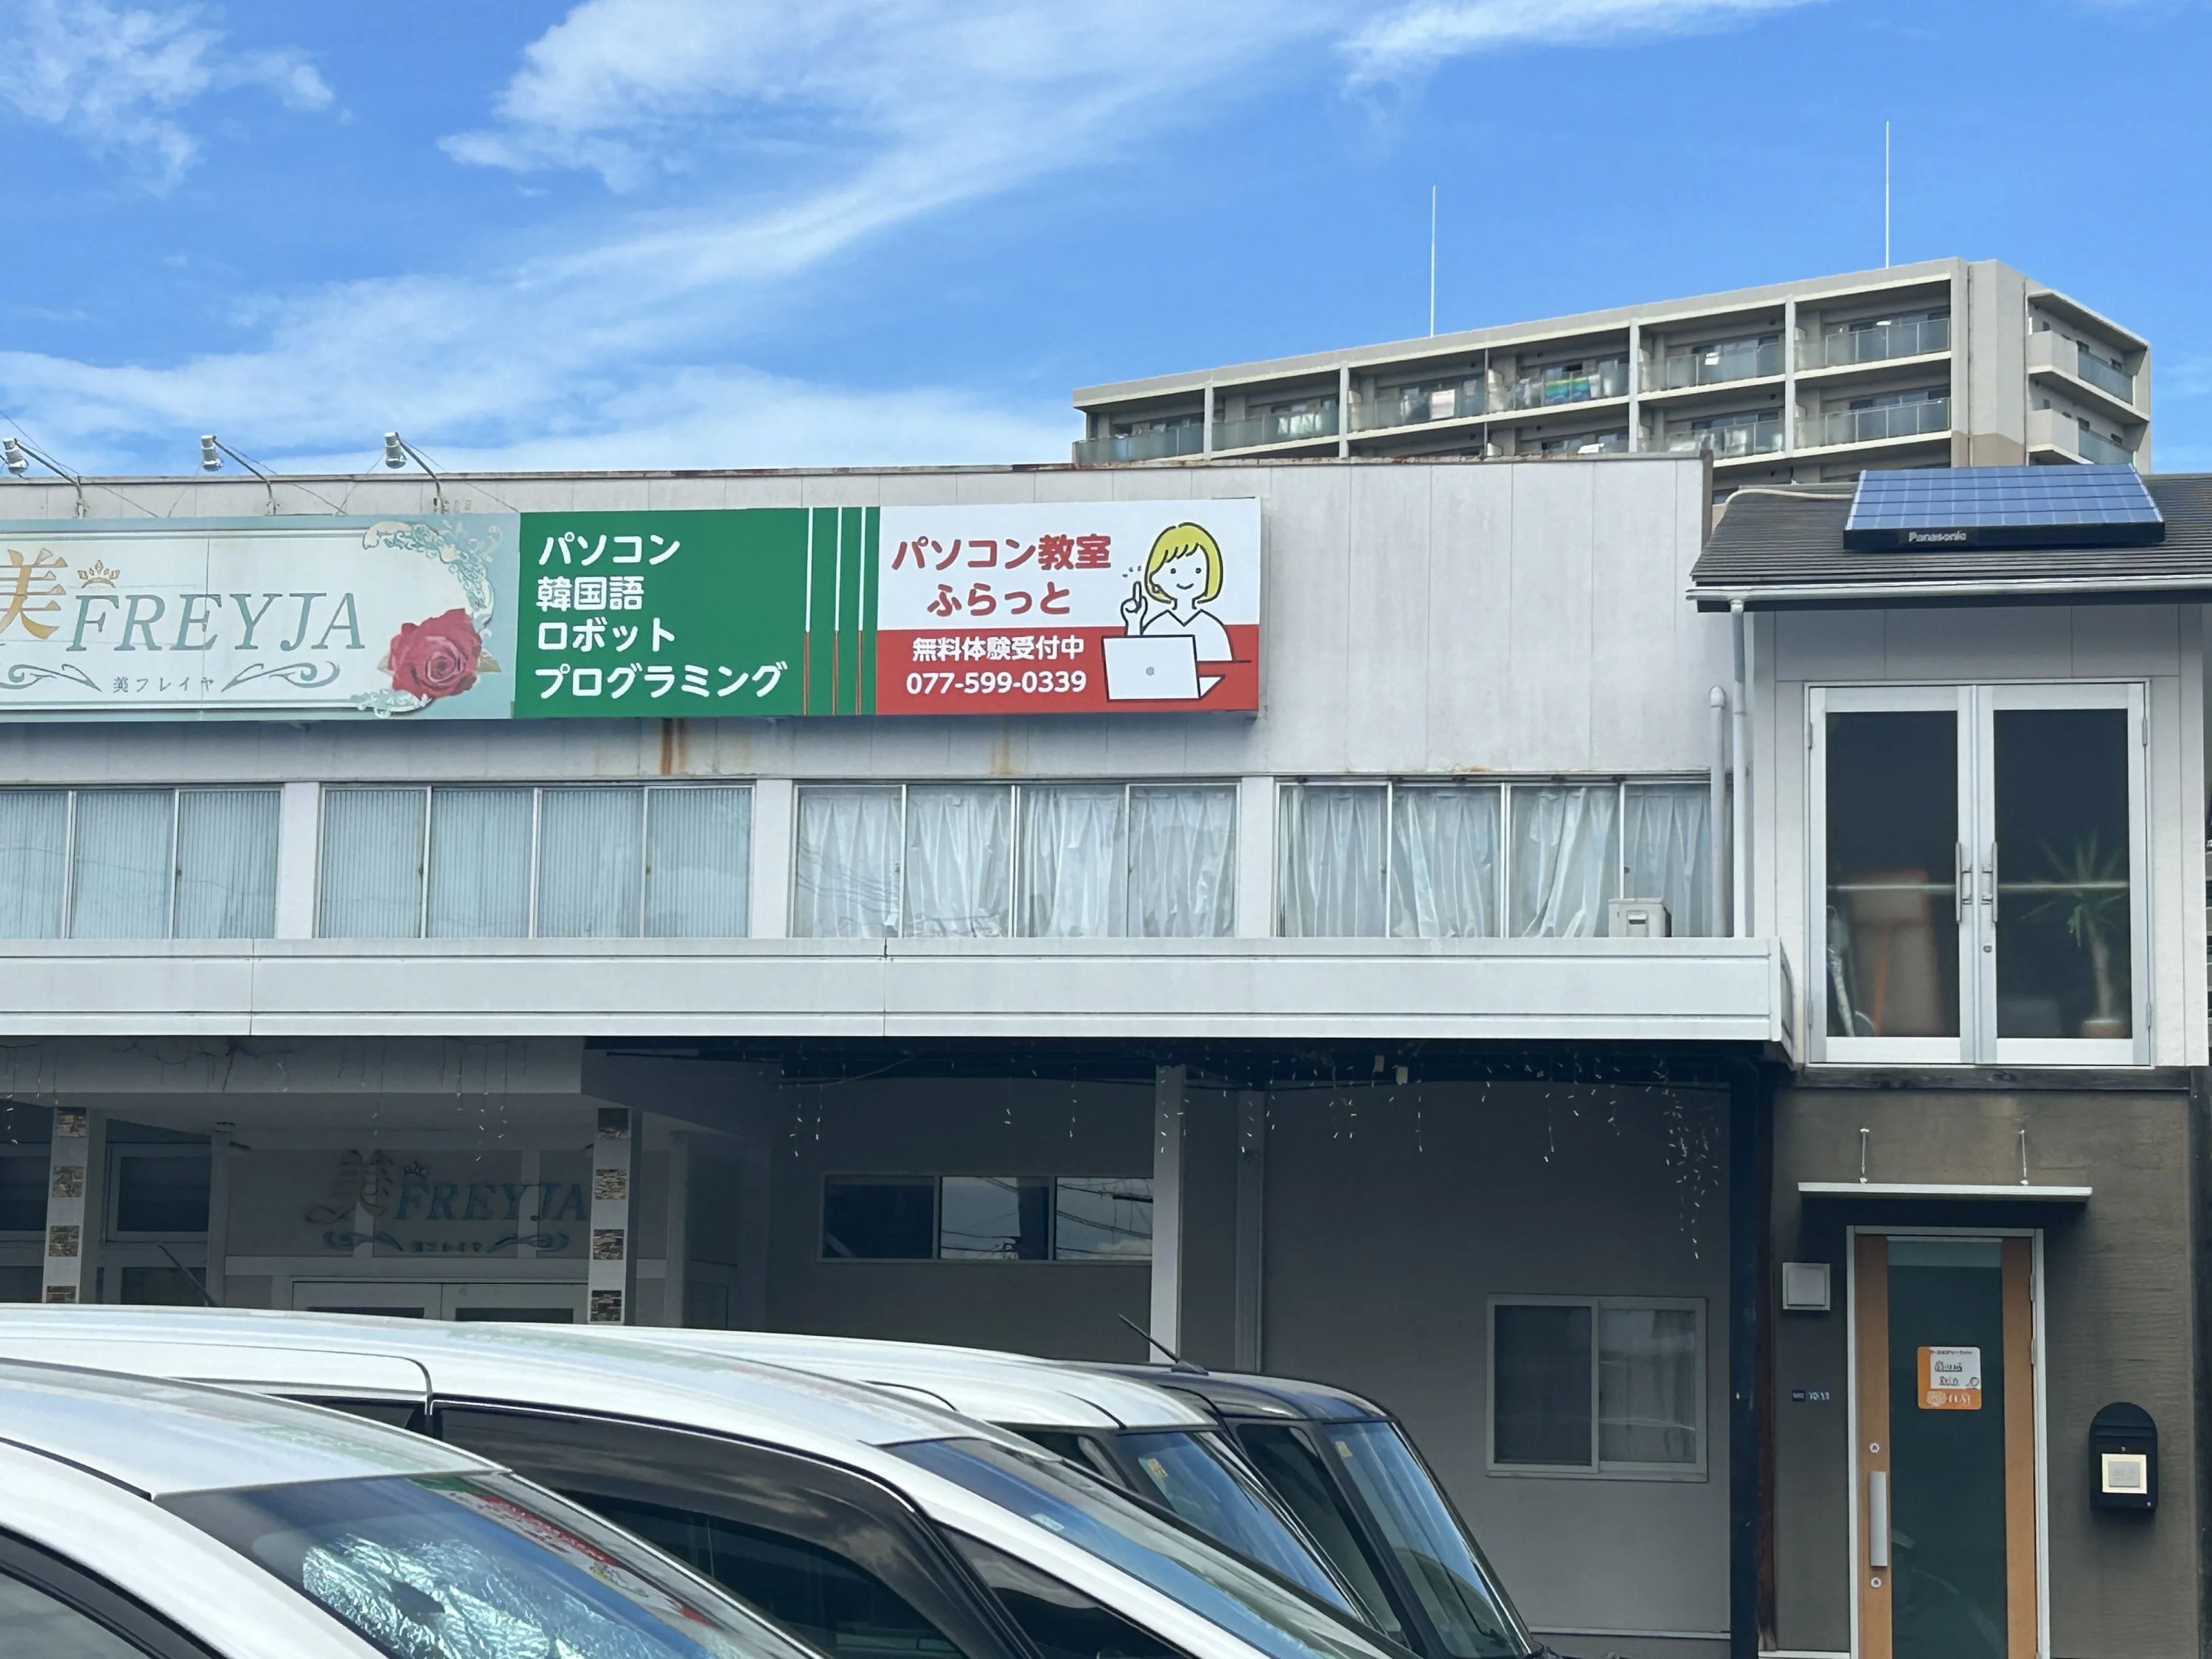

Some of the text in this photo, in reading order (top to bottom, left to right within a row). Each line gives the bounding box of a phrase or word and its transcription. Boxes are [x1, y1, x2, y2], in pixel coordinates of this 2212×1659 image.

[538, 531, 680, 566] パソコン
[891, 534, 1111, 571] パソコン教室
[1908, 531, 1966, 542] Panasonic
[536, 575, 644, 612] 韓国語
[927, 581, 1071, 616] ふらっと
[66, 592, 366, 651] FREYJA
[538, 616, 675, 652] ロボット
[912, 636, 1085, 662] 無料体験受付中
[535, 661, 788, 699] プログラミング
[906, 671, 1087, 695] 077-599-0339
[394, 1181, 588, 1221] FREYJA
